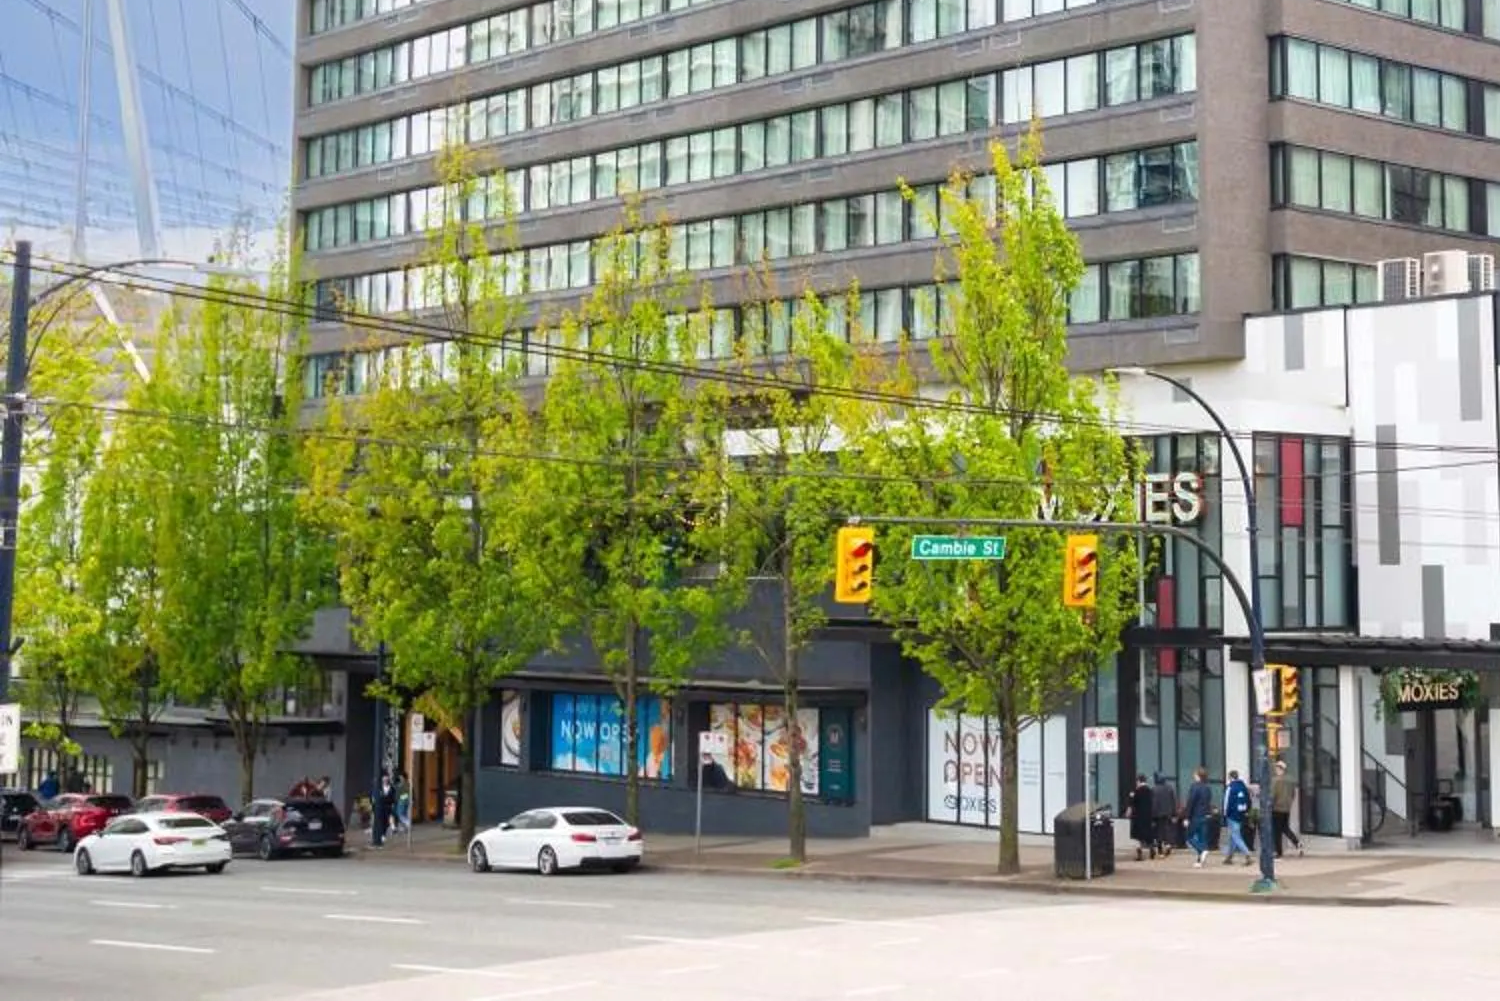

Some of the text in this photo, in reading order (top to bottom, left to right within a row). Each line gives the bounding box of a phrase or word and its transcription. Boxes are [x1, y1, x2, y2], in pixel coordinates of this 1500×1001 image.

[919, 539, 999, 556] Cambie St
[1398, 682, 1459, 703] MOXIES
[561, 719, 640, 743] NOW OPE
[944, 730, 1000, 756] NOW
[943, 759, 1002, 787] OPEN
